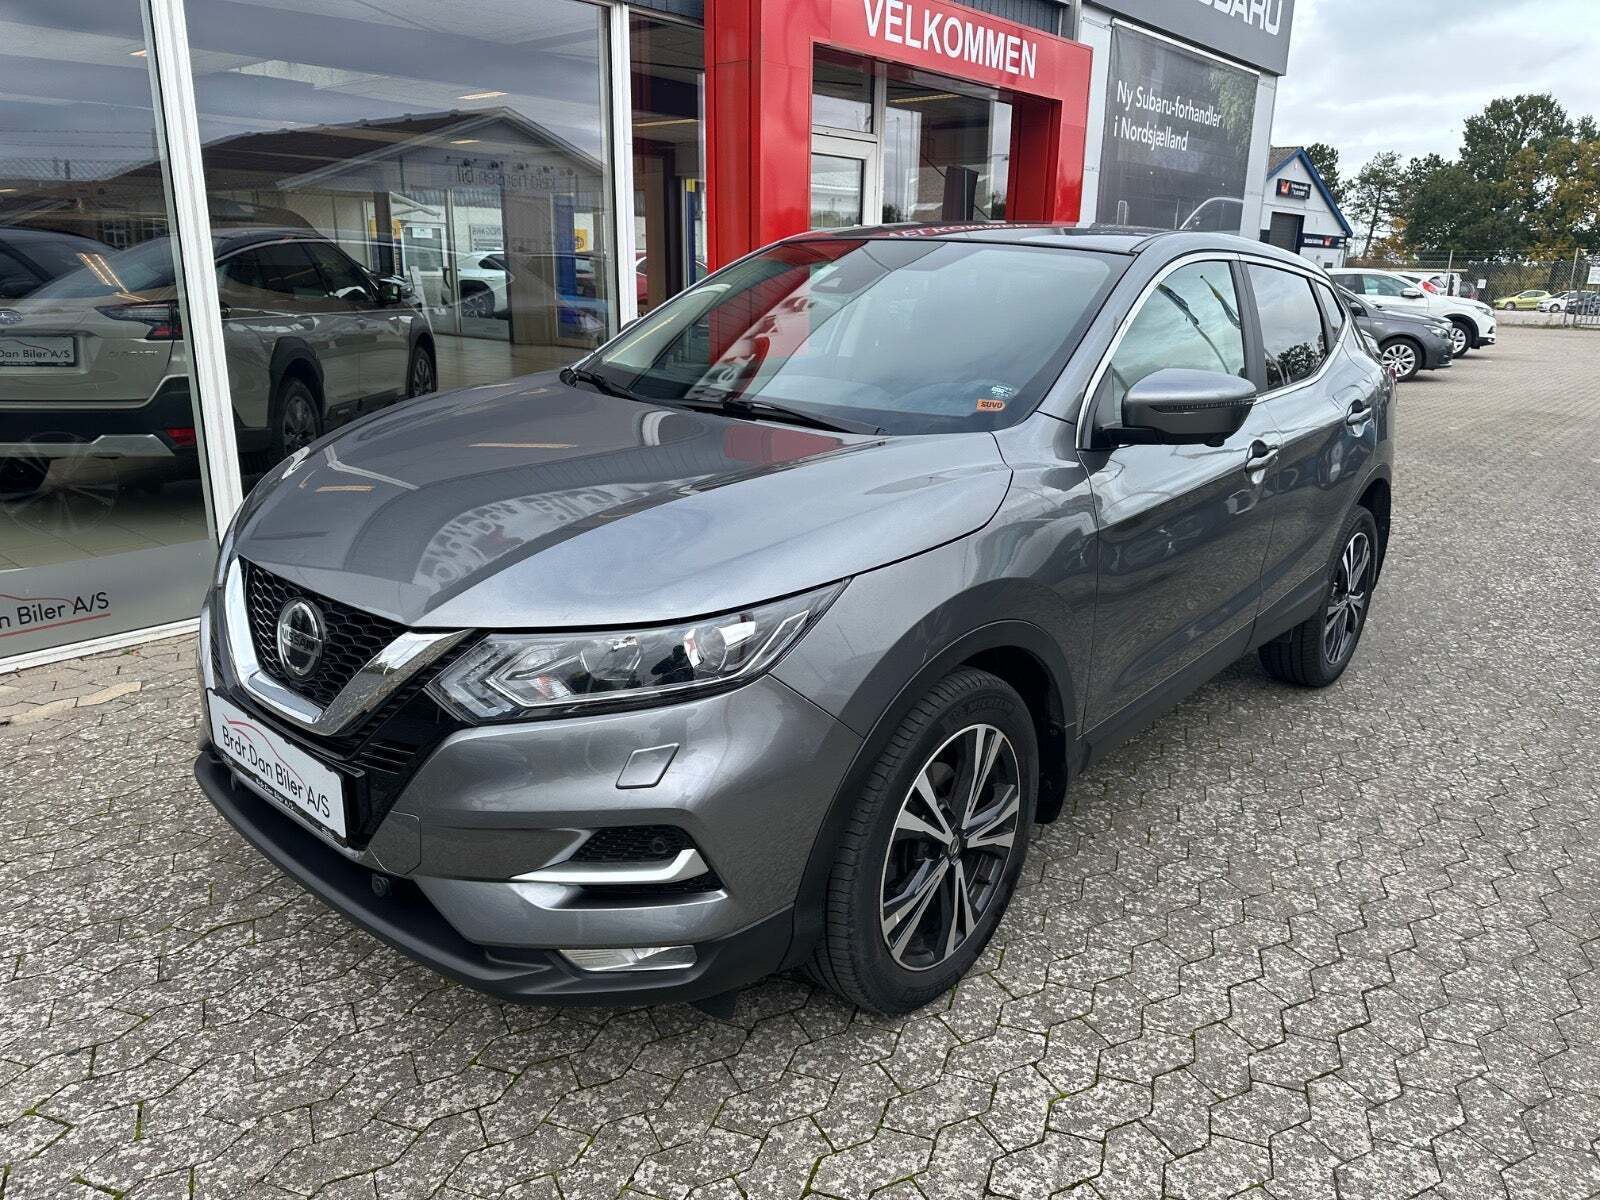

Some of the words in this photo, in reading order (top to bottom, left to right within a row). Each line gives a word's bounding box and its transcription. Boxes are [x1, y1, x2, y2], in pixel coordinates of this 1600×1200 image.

[1198, 0, 1282, 35] ARU
[863, 0, 1037, 79] VELKOMMEN
[1117, 80, 1133, 111] Ny
[1136, 86, 1222, 127] Subaru-forhandler
[1114, 115, 1118, 137] i
[1121, 116, 1189, 151] Nordsjælland
[22, 348, 48, 358] Biler
[16, 603, 66, 625] Biler
[72, 591, 109, 615] A/S
[276, 763, 303, 798] Biler
[307, 787, 330, 819] A/S
